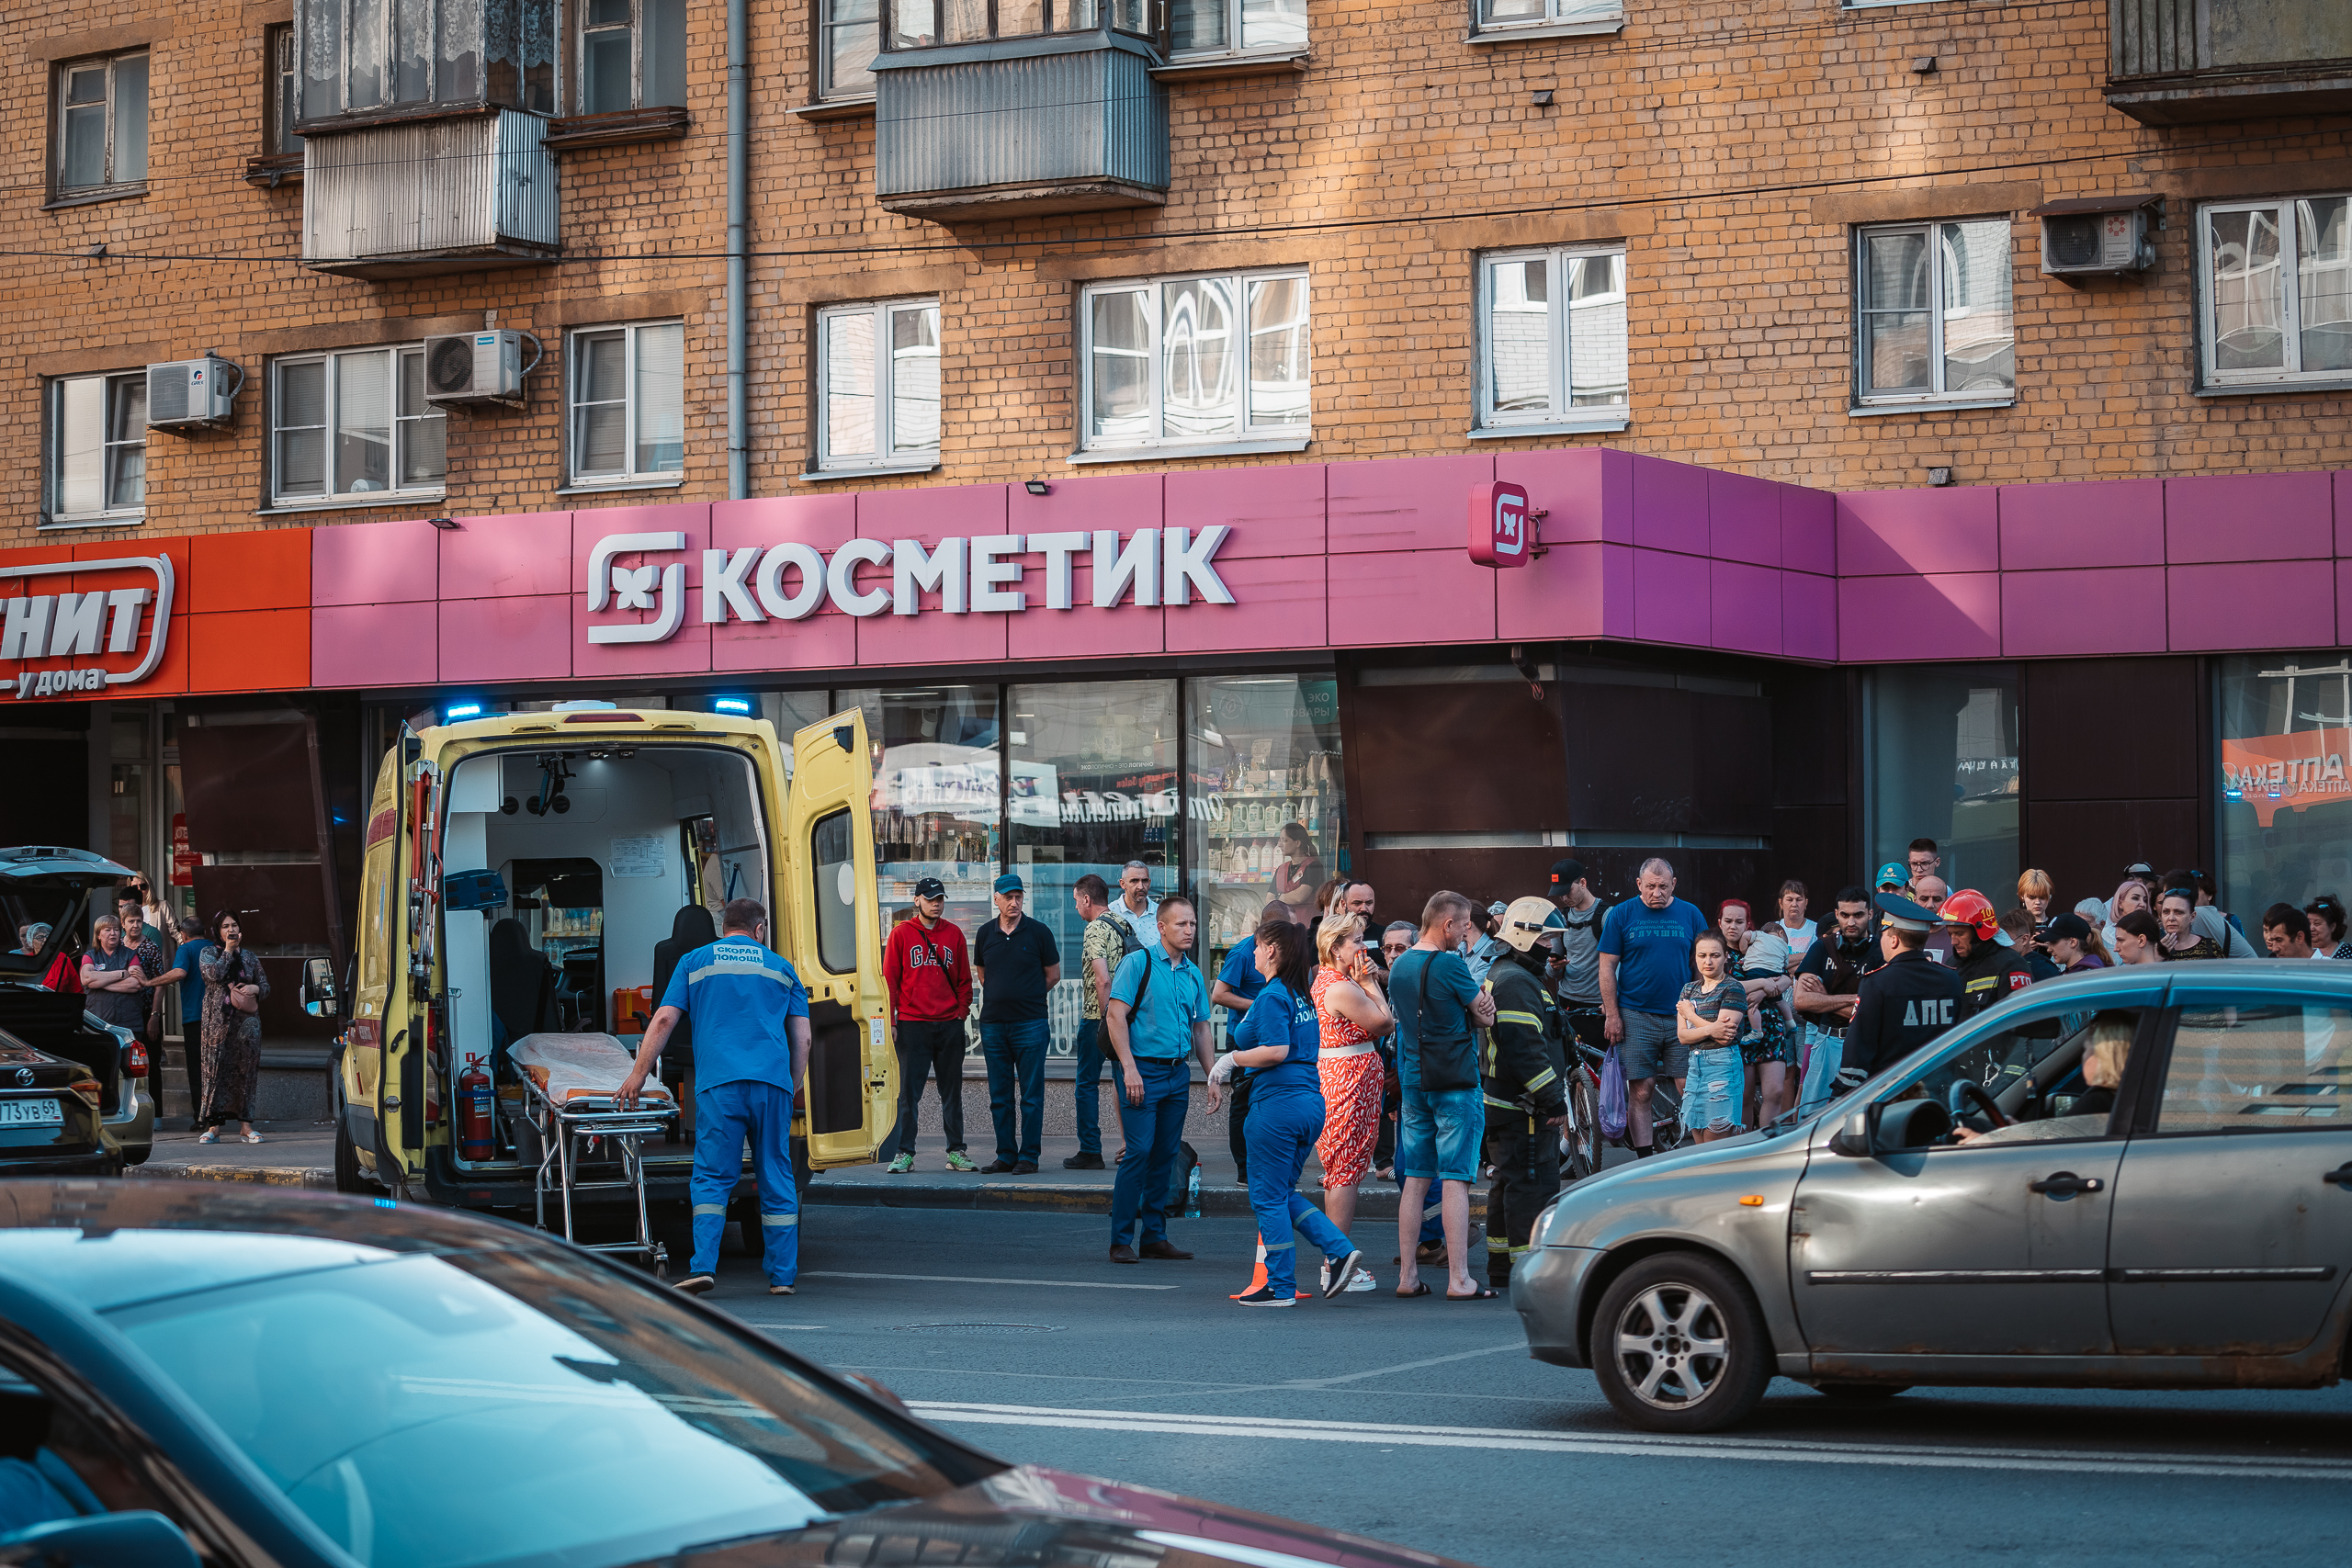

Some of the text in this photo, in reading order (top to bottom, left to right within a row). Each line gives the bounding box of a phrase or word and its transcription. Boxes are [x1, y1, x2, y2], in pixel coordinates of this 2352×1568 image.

[703, 525, 1237, 623] КОСМЕТИК
[0, 588, 153, 660] НИТ
[35, 668, 107, 695] дома
[1307, 693, 1329, 703] ЭКО
[1283, 707, 1330, 717] ТОВАРЫ
[714, 954, 763, 963] ПОМОЩЬ
[910, 943, 953, 969] GAP
[2009, 975, 2031, 987] РТП
[1903, 999, 1953, 1025] ДПС
[0, 1100, 55, 1121] 73УВ 69
